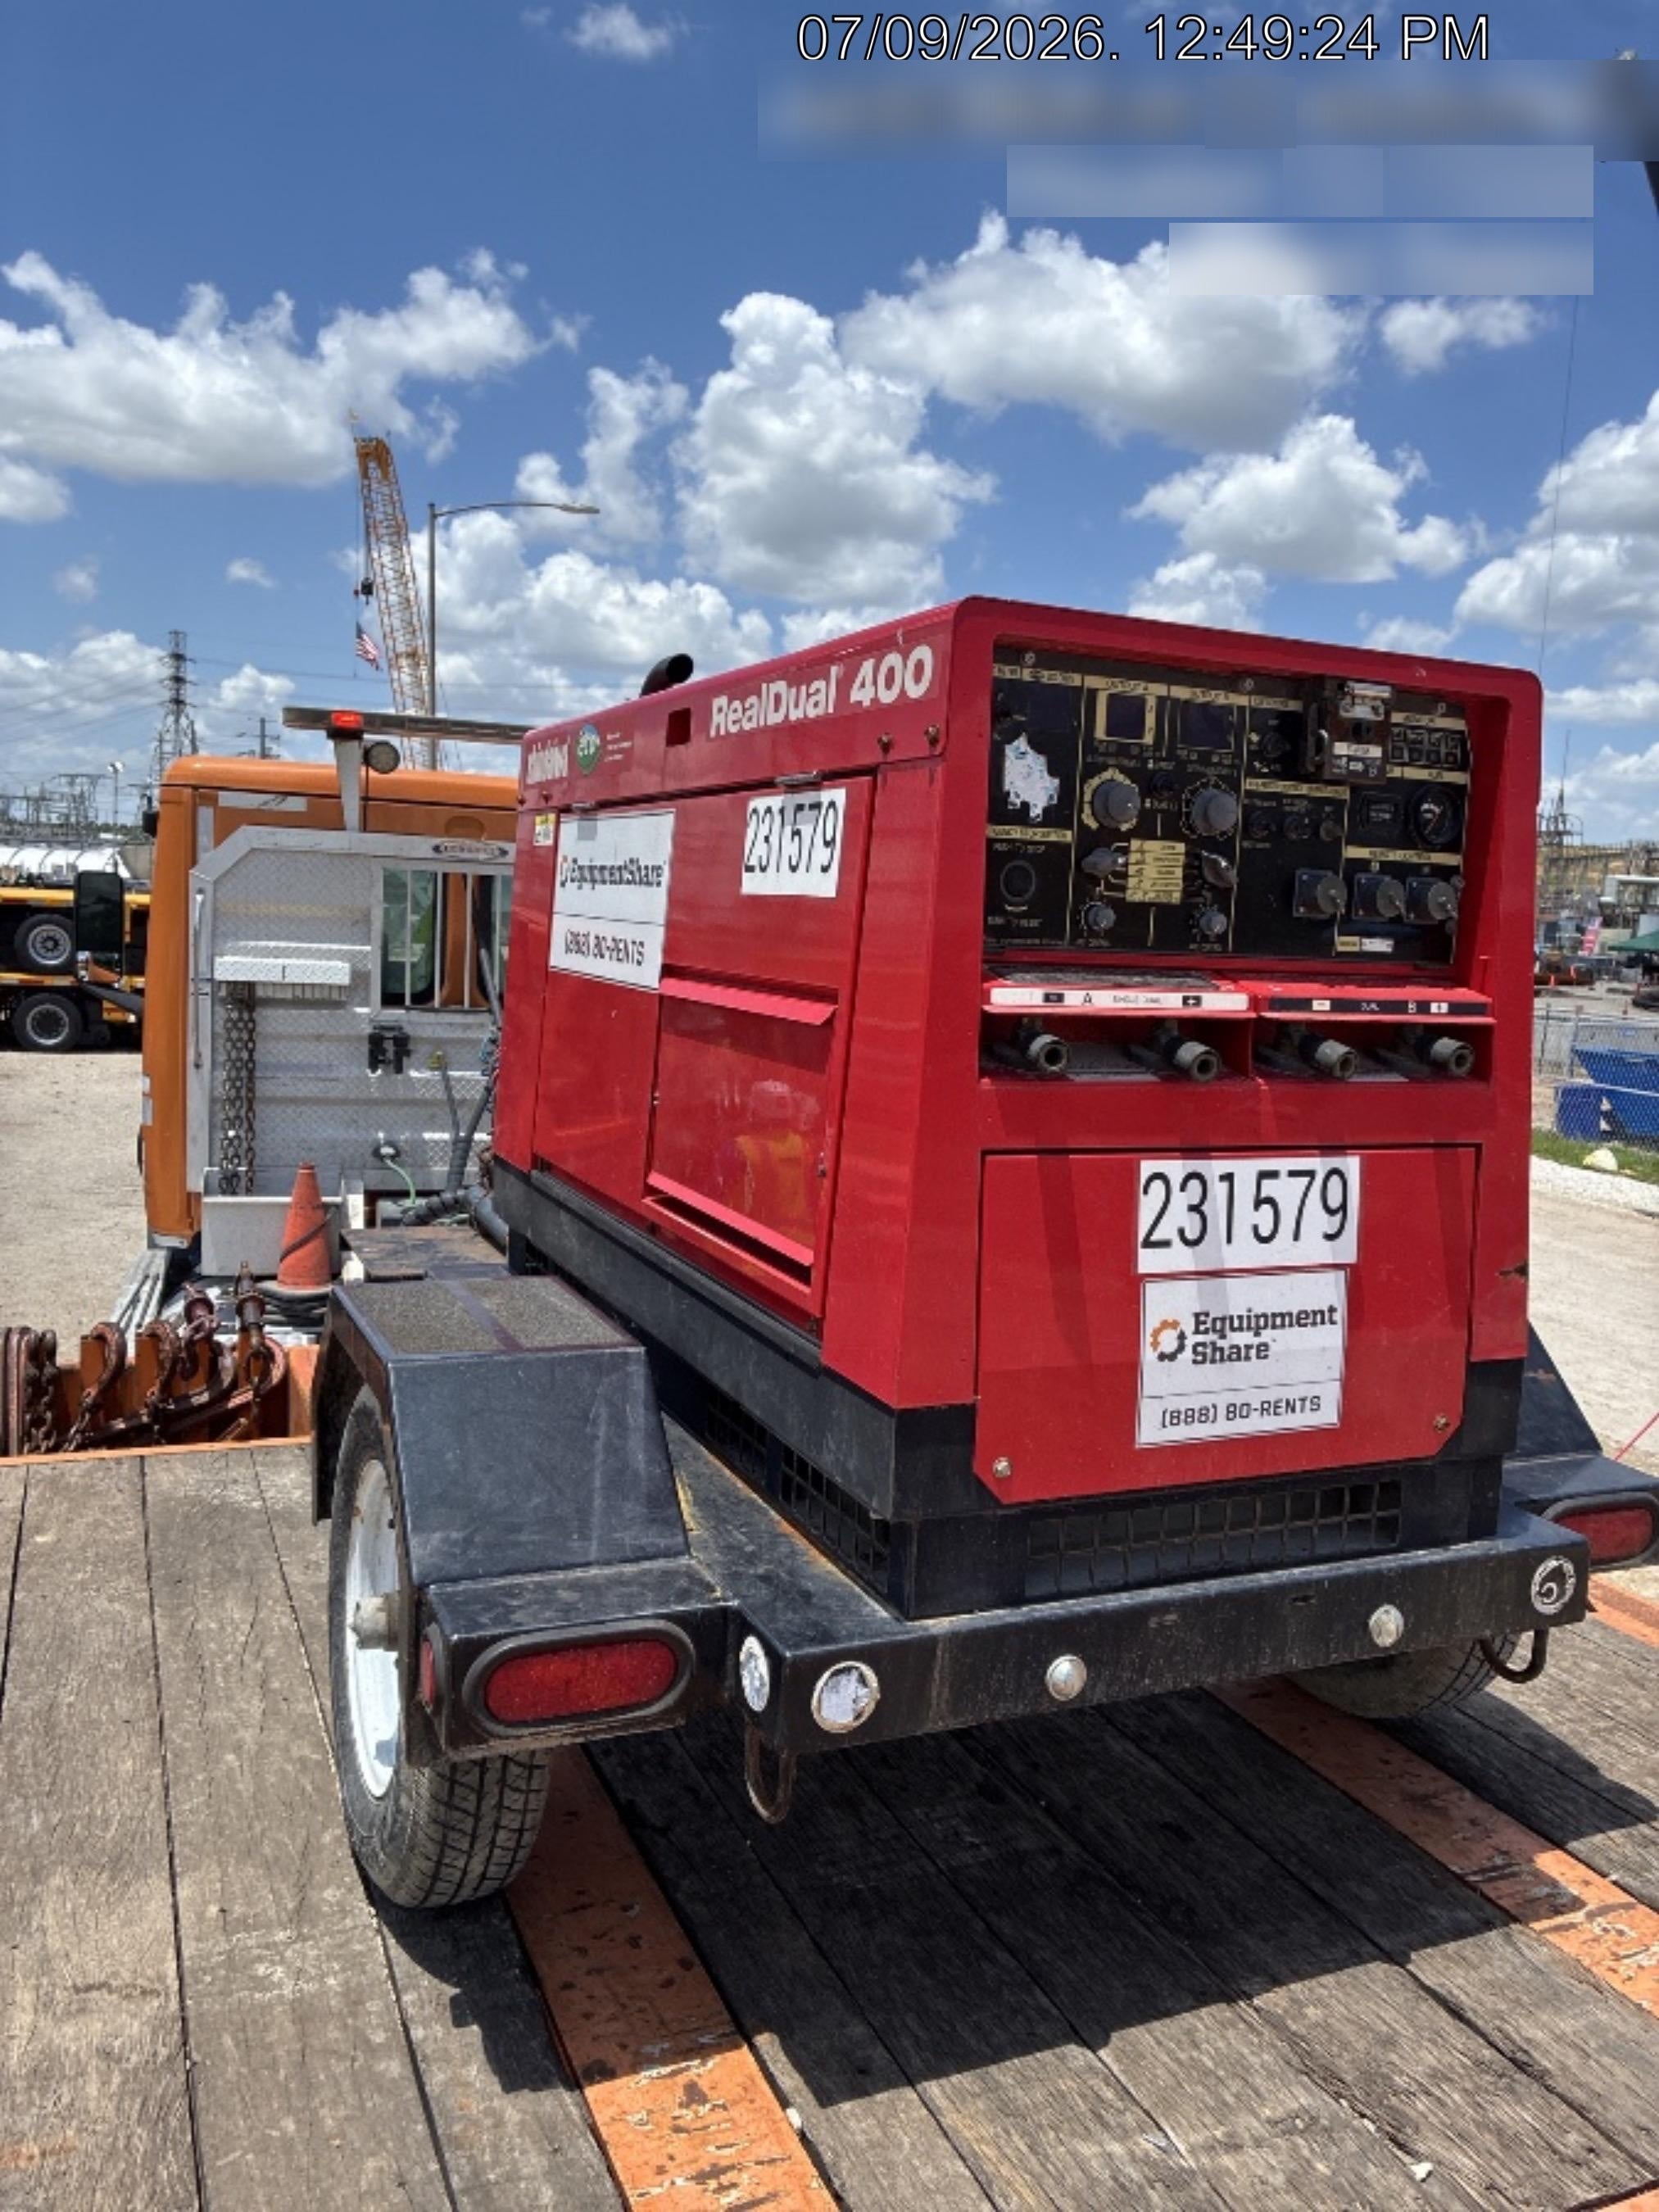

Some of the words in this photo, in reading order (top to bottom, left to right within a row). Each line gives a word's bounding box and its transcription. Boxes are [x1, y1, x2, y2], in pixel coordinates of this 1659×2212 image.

[709, 664, 838, 738] RealDual
[850, 645, 932, 708] 400
[743, 800, 839, 875] 231579
[1140, 1166, 1349, 1249] 231579
[1191, 1304, 1339, 1339] Equipment
[1190, 1339, 1271, 1366] Share
[1161, 1403, 1218, 1430] (888)
[1225, 1394, 1321, 1422] 80-RENTS
